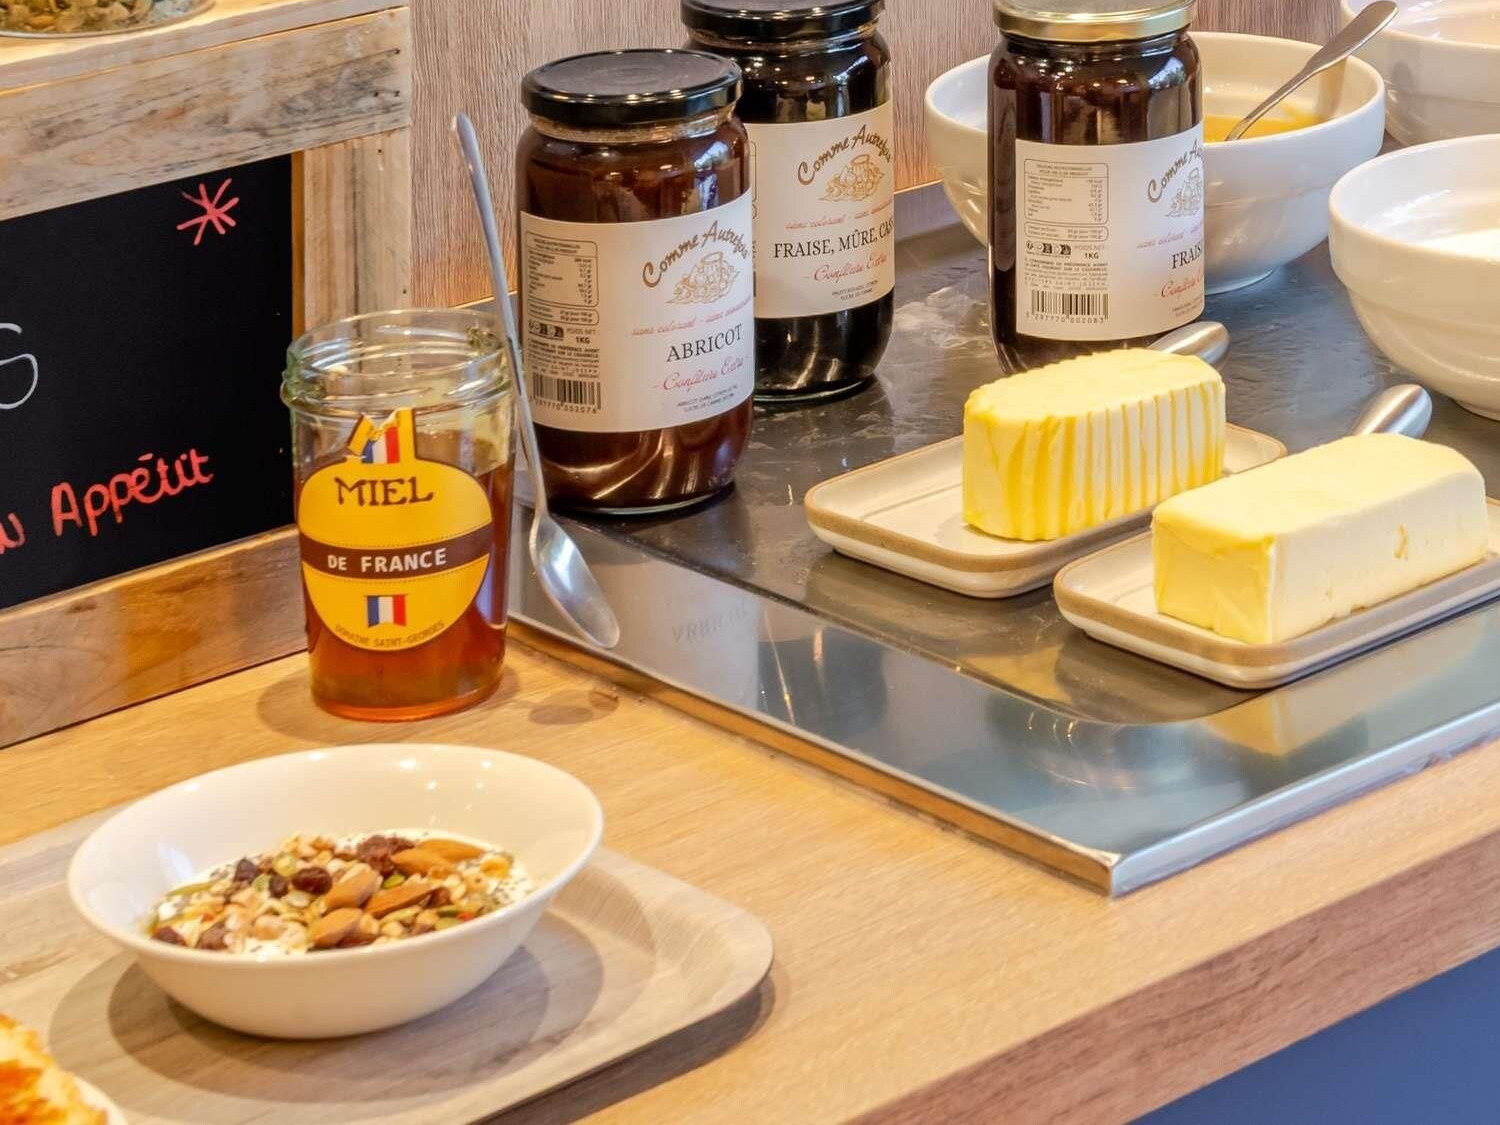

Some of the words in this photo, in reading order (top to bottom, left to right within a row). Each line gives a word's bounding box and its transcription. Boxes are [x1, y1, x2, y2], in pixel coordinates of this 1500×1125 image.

[798, 136, 850, 186] Comme
[1148, 151, 1188, 203] Comme
[642, 234, 700, 288] Comme
[773, 239, 835, 259] FRAISE,
[838, 229, 878, 252] MÛRE,
[1085, 252, 1099, 260] 1KG
[575, 336, 591, 344] 1KG
[666, 323, 742, 363] ABRICOT
[51, 448, 214, 537] Appétit
[334, 476, 434, 507] MIEL
[327, 554, 348, 572] DE
[361, 547, 447, 573] FRANCE
